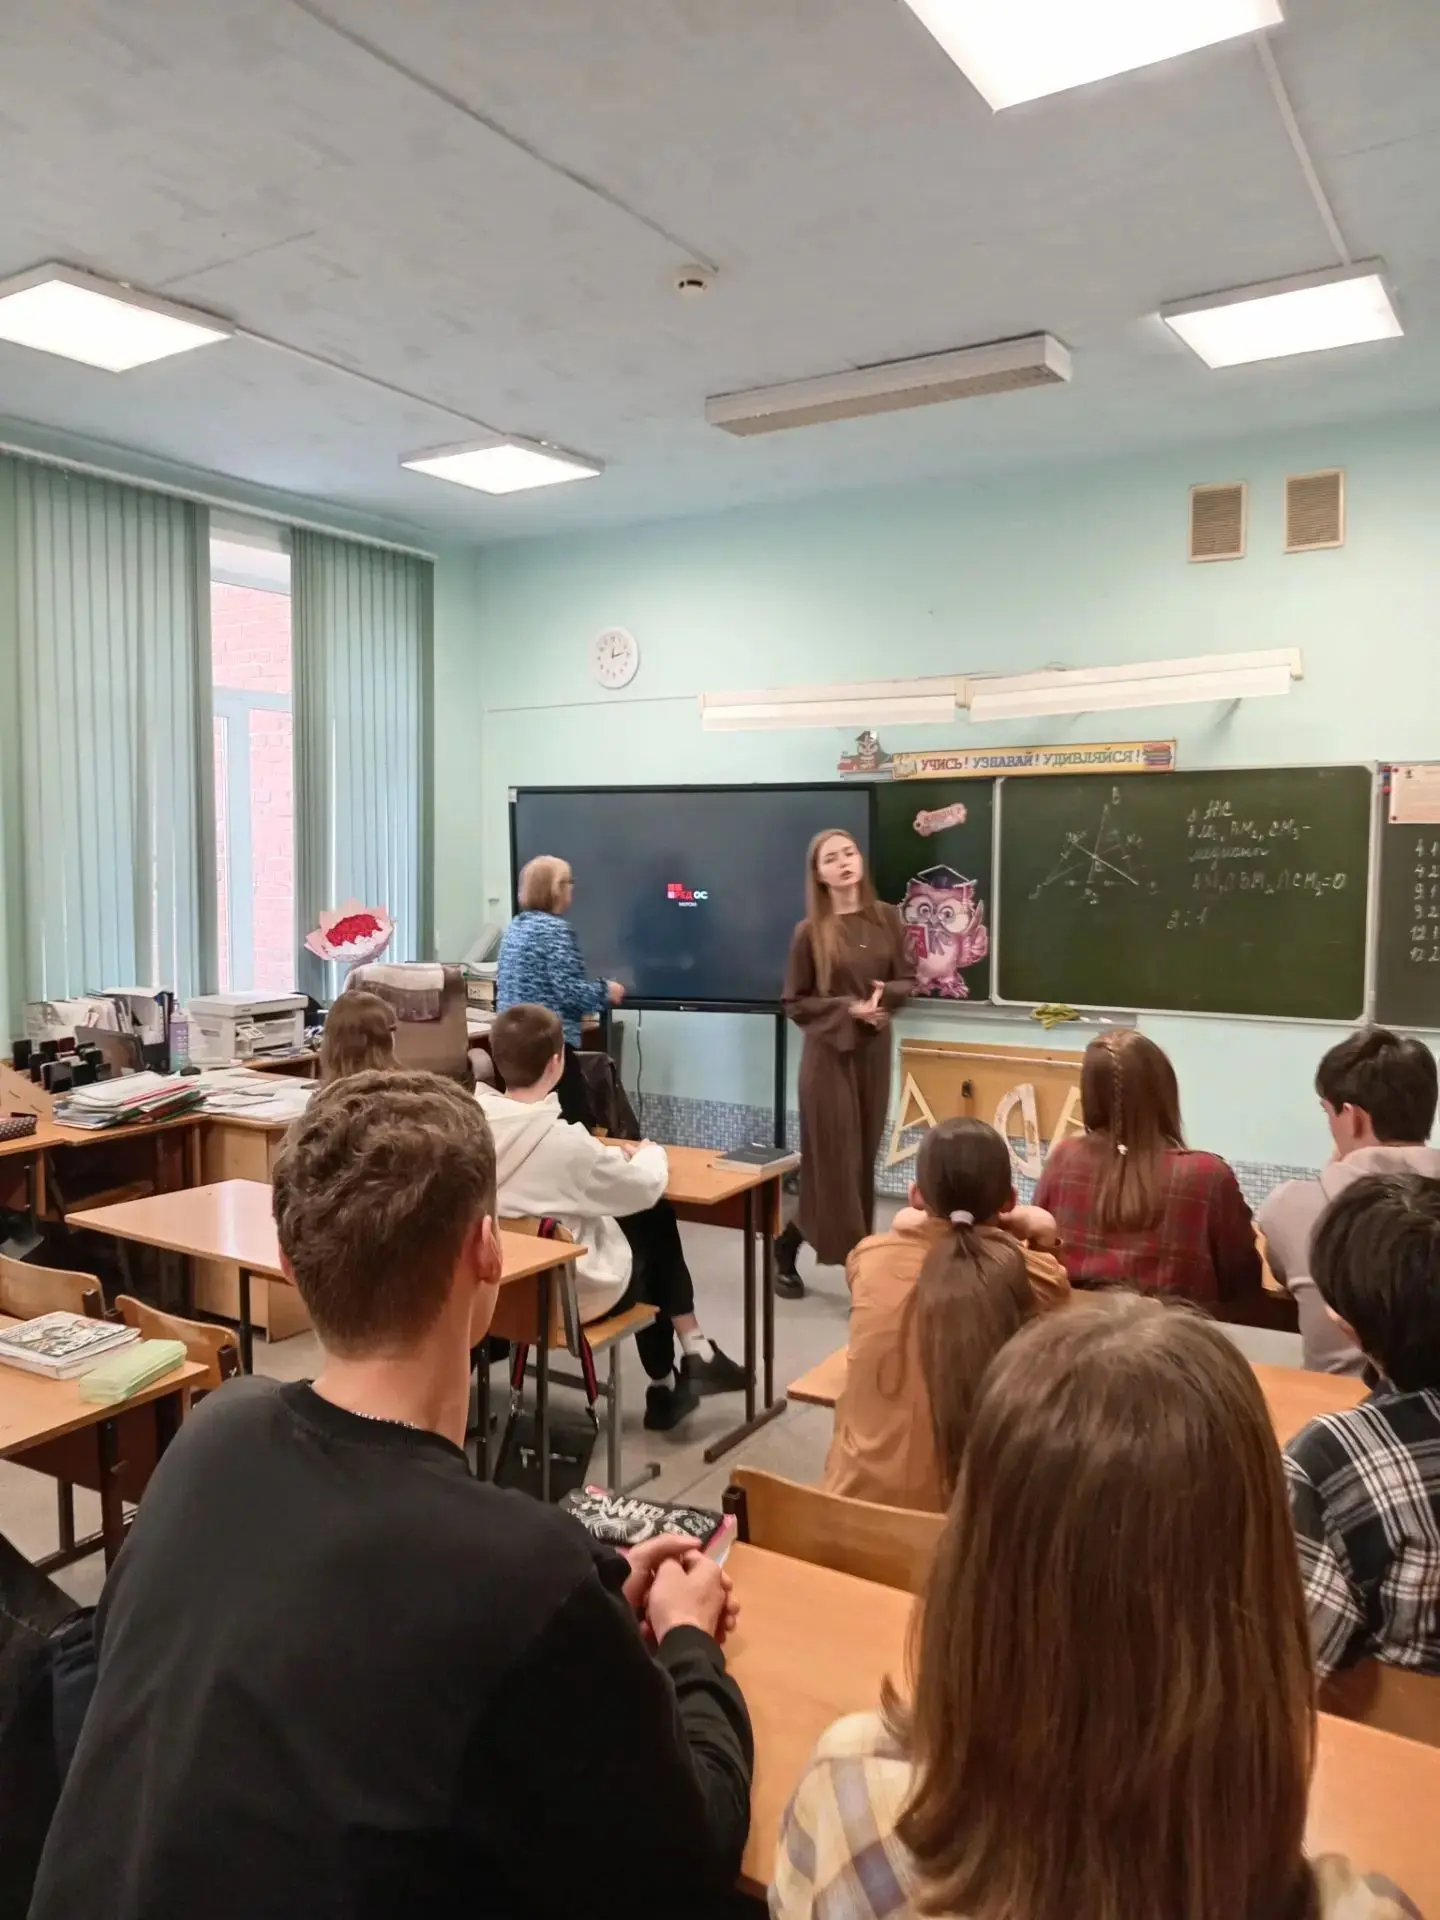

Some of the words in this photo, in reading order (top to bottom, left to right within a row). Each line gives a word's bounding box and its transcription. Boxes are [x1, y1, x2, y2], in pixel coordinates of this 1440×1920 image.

[921, 757, 968, 771] УЧИСЬ!
[972, 751, 1039, 769] УЗНАВАЙ!
[1042, 747, 1141, 766] УДИВЛЯЙСЯ!
